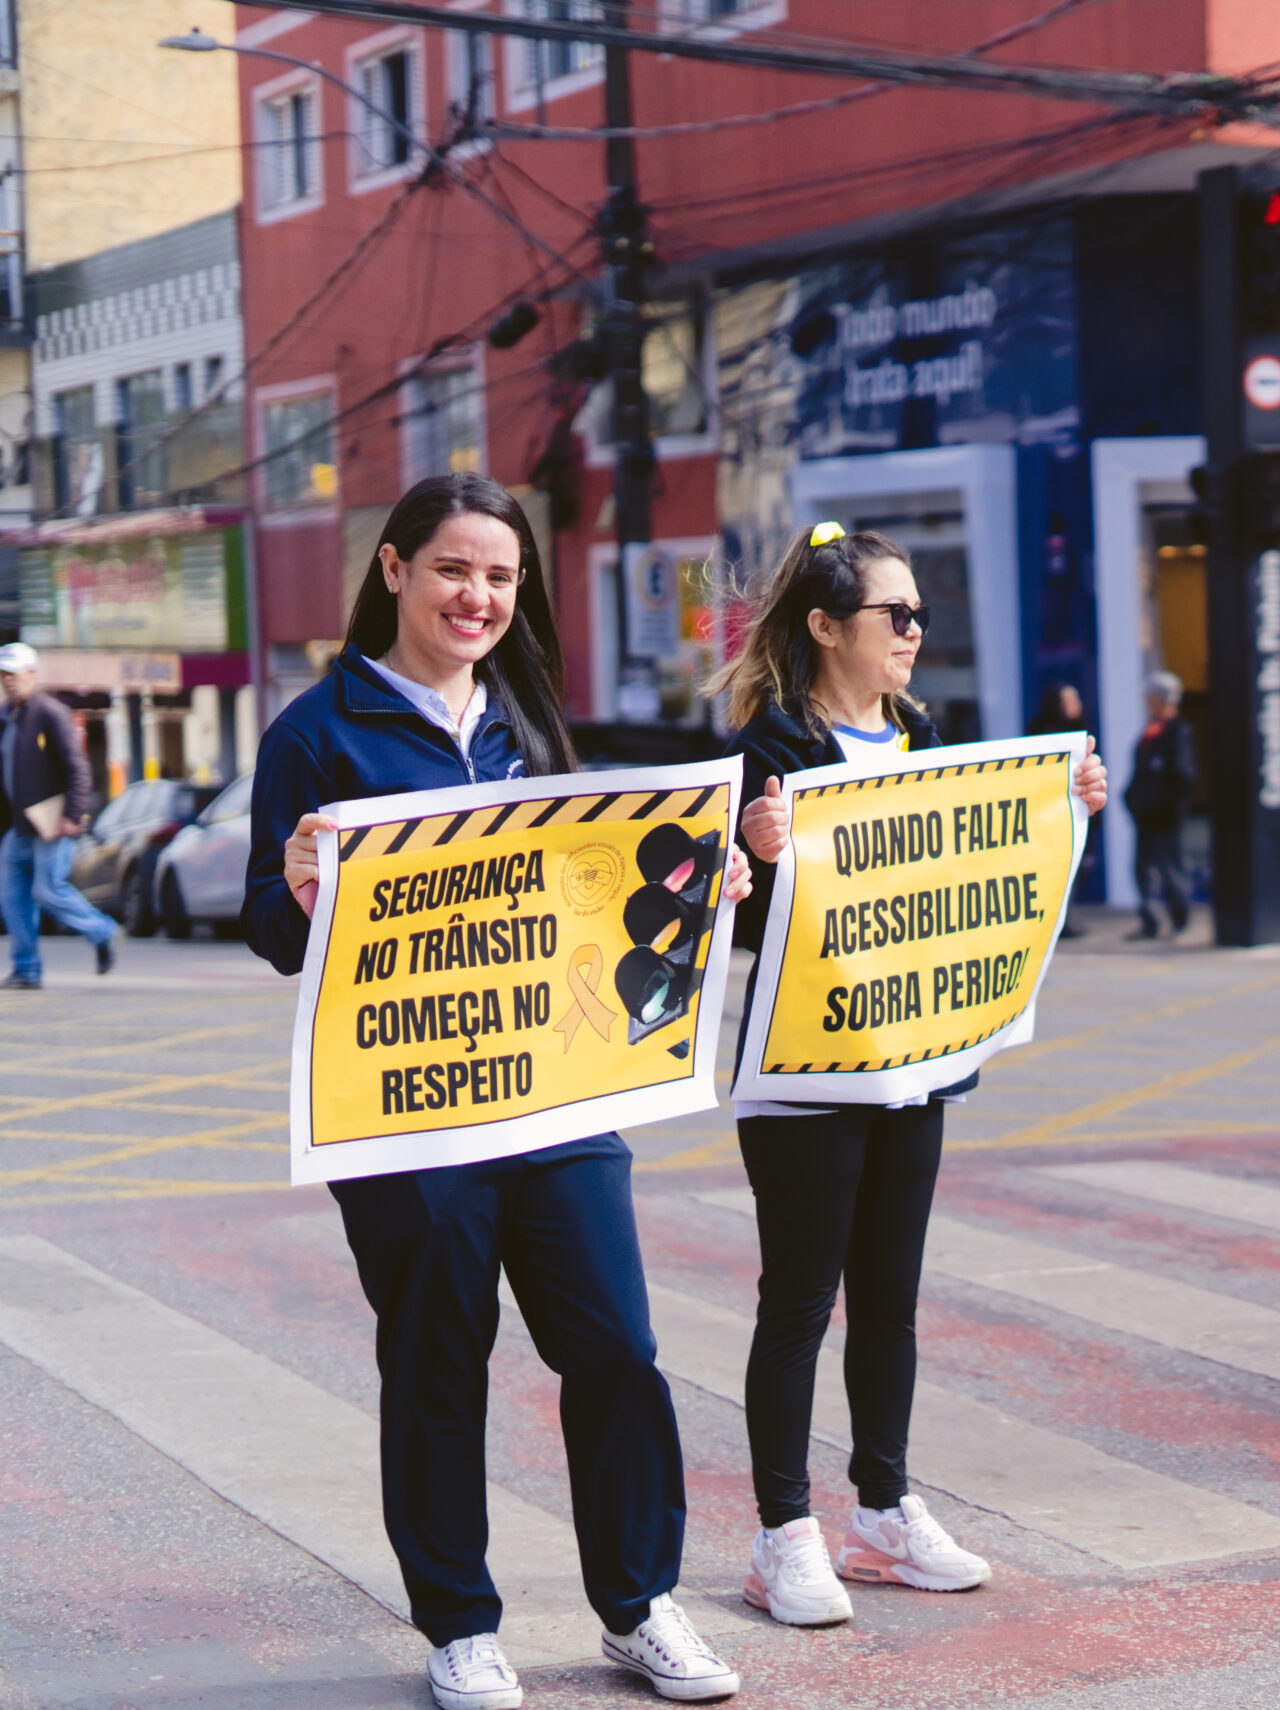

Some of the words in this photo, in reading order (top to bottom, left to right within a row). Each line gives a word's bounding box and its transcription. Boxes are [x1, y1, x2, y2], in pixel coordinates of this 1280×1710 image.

[900, 279, 997, 335] mundo
[833, 810, 943, 878] QUANDO
[953, 797, 1029, 855] FALTA
[369, 848, 545, 922] SEGURANÇA
[819, 872, 1045, 959] ACESSIBILIDADE,
[353, 937, 399, 985] NO
[409, 912, 557, 975] TRÂNSITO
[356, 988, 503, 1053] COMEÇA
[513, 981, 550, 1031] NO
[822, 970, 922, 1033] SOBRA
[933, 947, 1030, 1015] PERIGO!
[381, 1051, 533, 1115] RESPEITO
